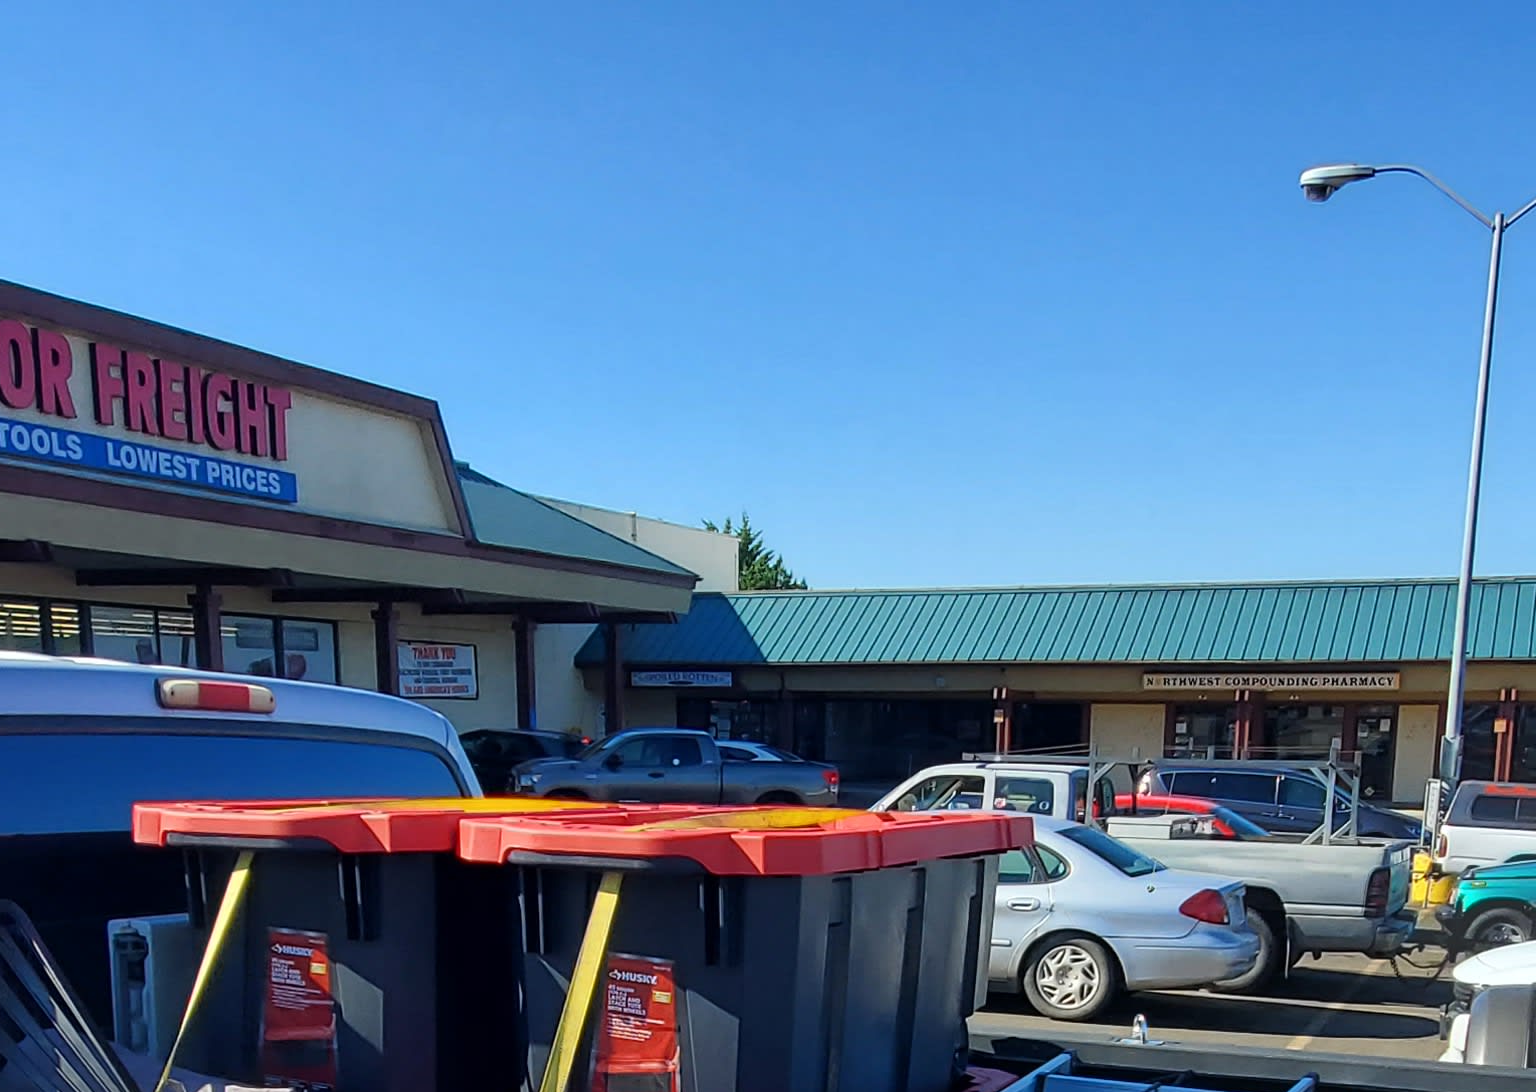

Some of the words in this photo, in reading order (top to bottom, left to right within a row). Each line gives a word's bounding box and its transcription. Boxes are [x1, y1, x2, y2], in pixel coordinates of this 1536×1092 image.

[90, 342, 293, 461] FREIGHT
[106, 440, 200, 482] LOWEST
[206, 461, 281, 495] PRICES
[1146, 677, 1220, 687] NRTHWEST
[1225, 677, 1318, 687] COMPOUNDING
[1322, 677, 1394, 687] PHARMACY
[283, 946, 312, 957] HUSKY
[622, 971, 658, 985] HUSKY
